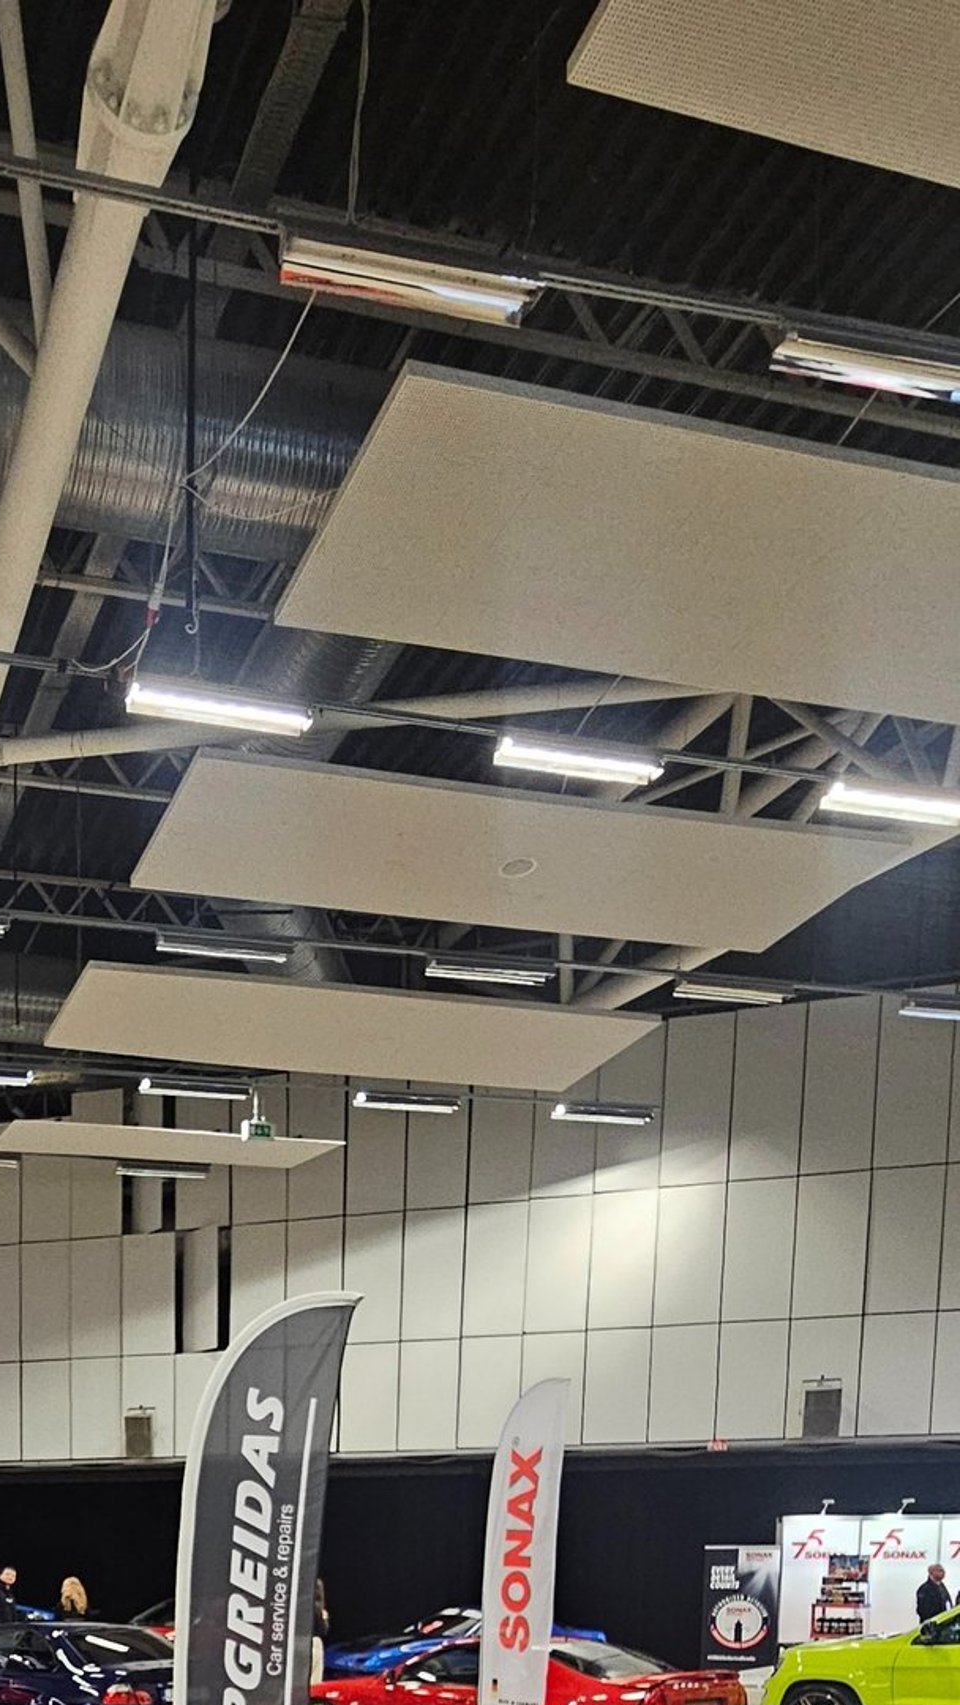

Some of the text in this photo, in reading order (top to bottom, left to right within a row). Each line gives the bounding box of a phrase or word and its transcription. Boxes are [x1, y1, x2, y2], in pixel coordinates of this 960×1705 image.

[266, 1504, 294, 1676] Car service & repairs
[499, 1446, 543, 1653] SONAX
[883, 1551, 927, 1559] SONAX
